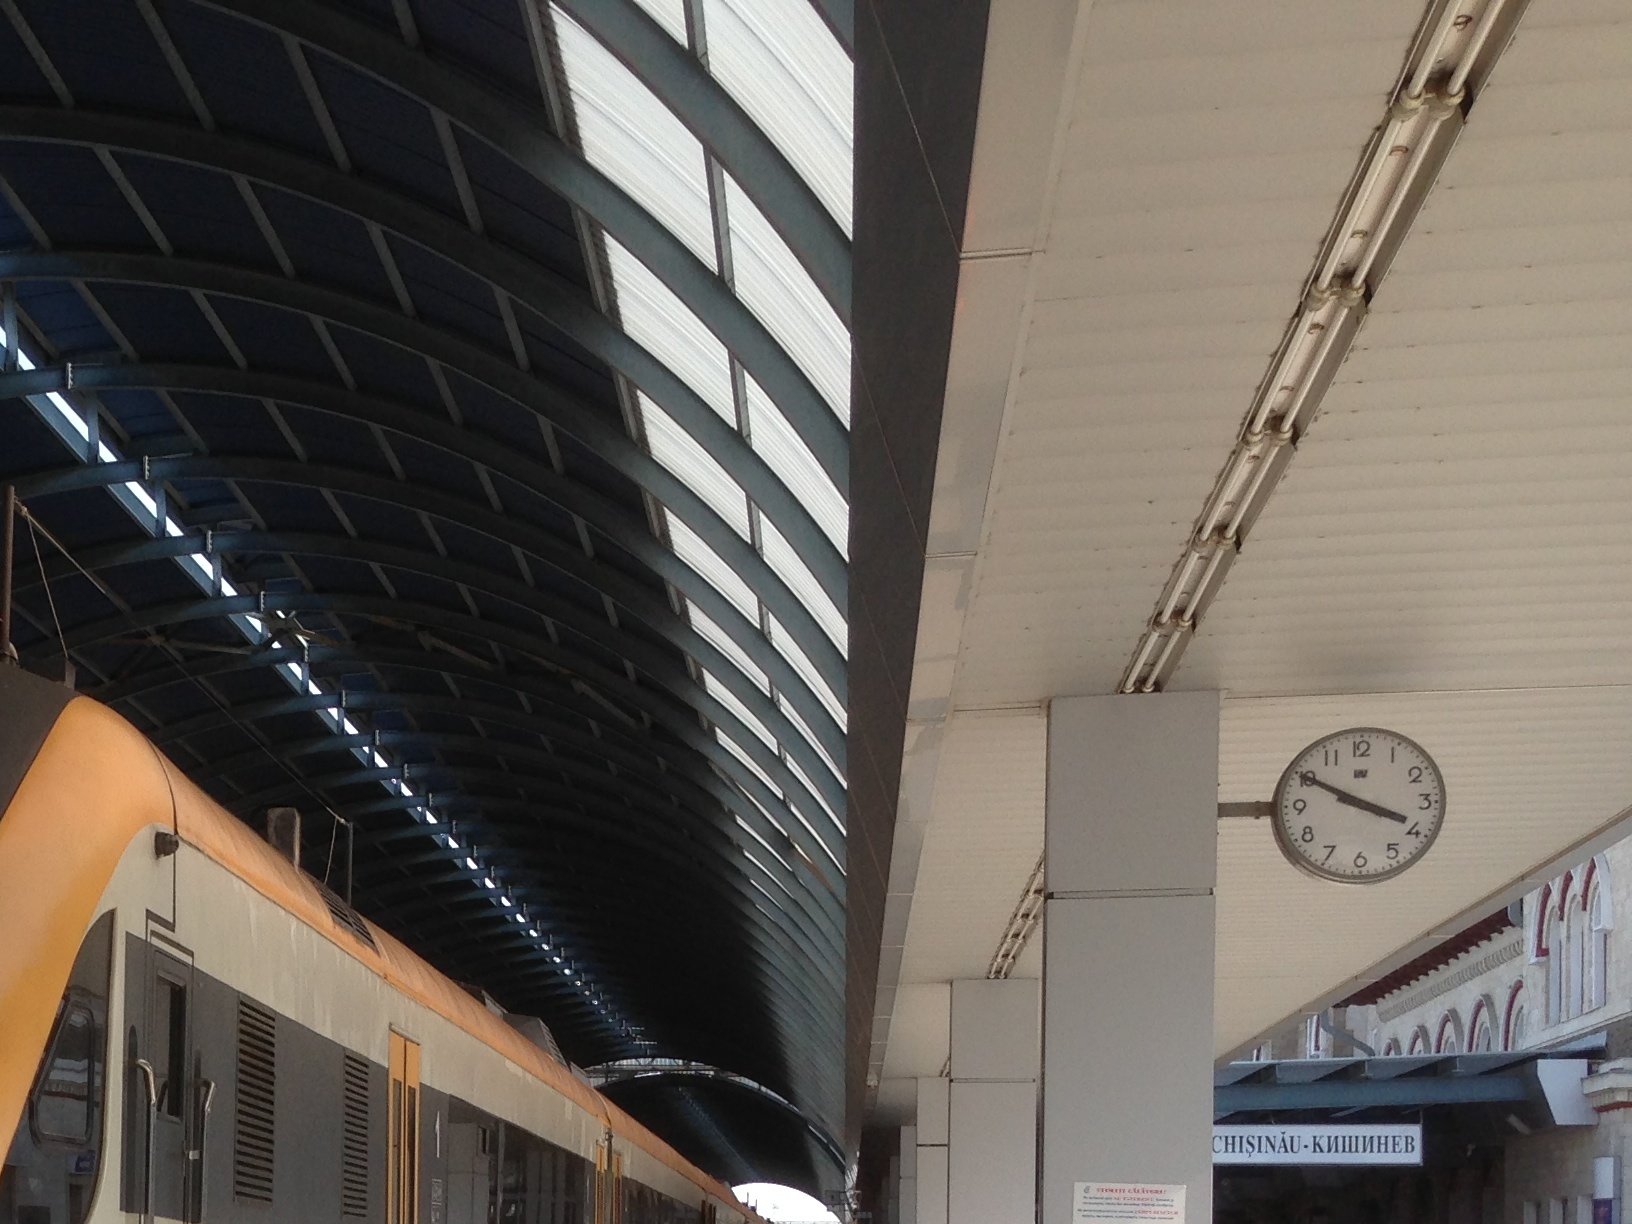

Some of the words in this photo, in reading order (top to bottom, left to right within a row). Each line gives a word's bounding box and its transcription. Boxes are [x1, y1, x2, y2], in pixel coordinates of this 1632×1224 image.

[1353, 740, 1370, 757] 12
[1391, 746, 1395, 764] 1
[1325, 749, 1338, 766] 11
[1408, 766, 1422, 783] 2
[1293, 799, 1306, 815] 9
[1419, 793, 1431, 810] 3
[1301, 826, 1314, 843] 8
[1405, 822, 1421, 839] 4
[1323, 845, 1336, 862] 7
[1353, 852, 1367, 868] 6
[1386, 843, 1399, 860] 5
[1311, 1135, 1416, 1154] КИШИНЕВ
